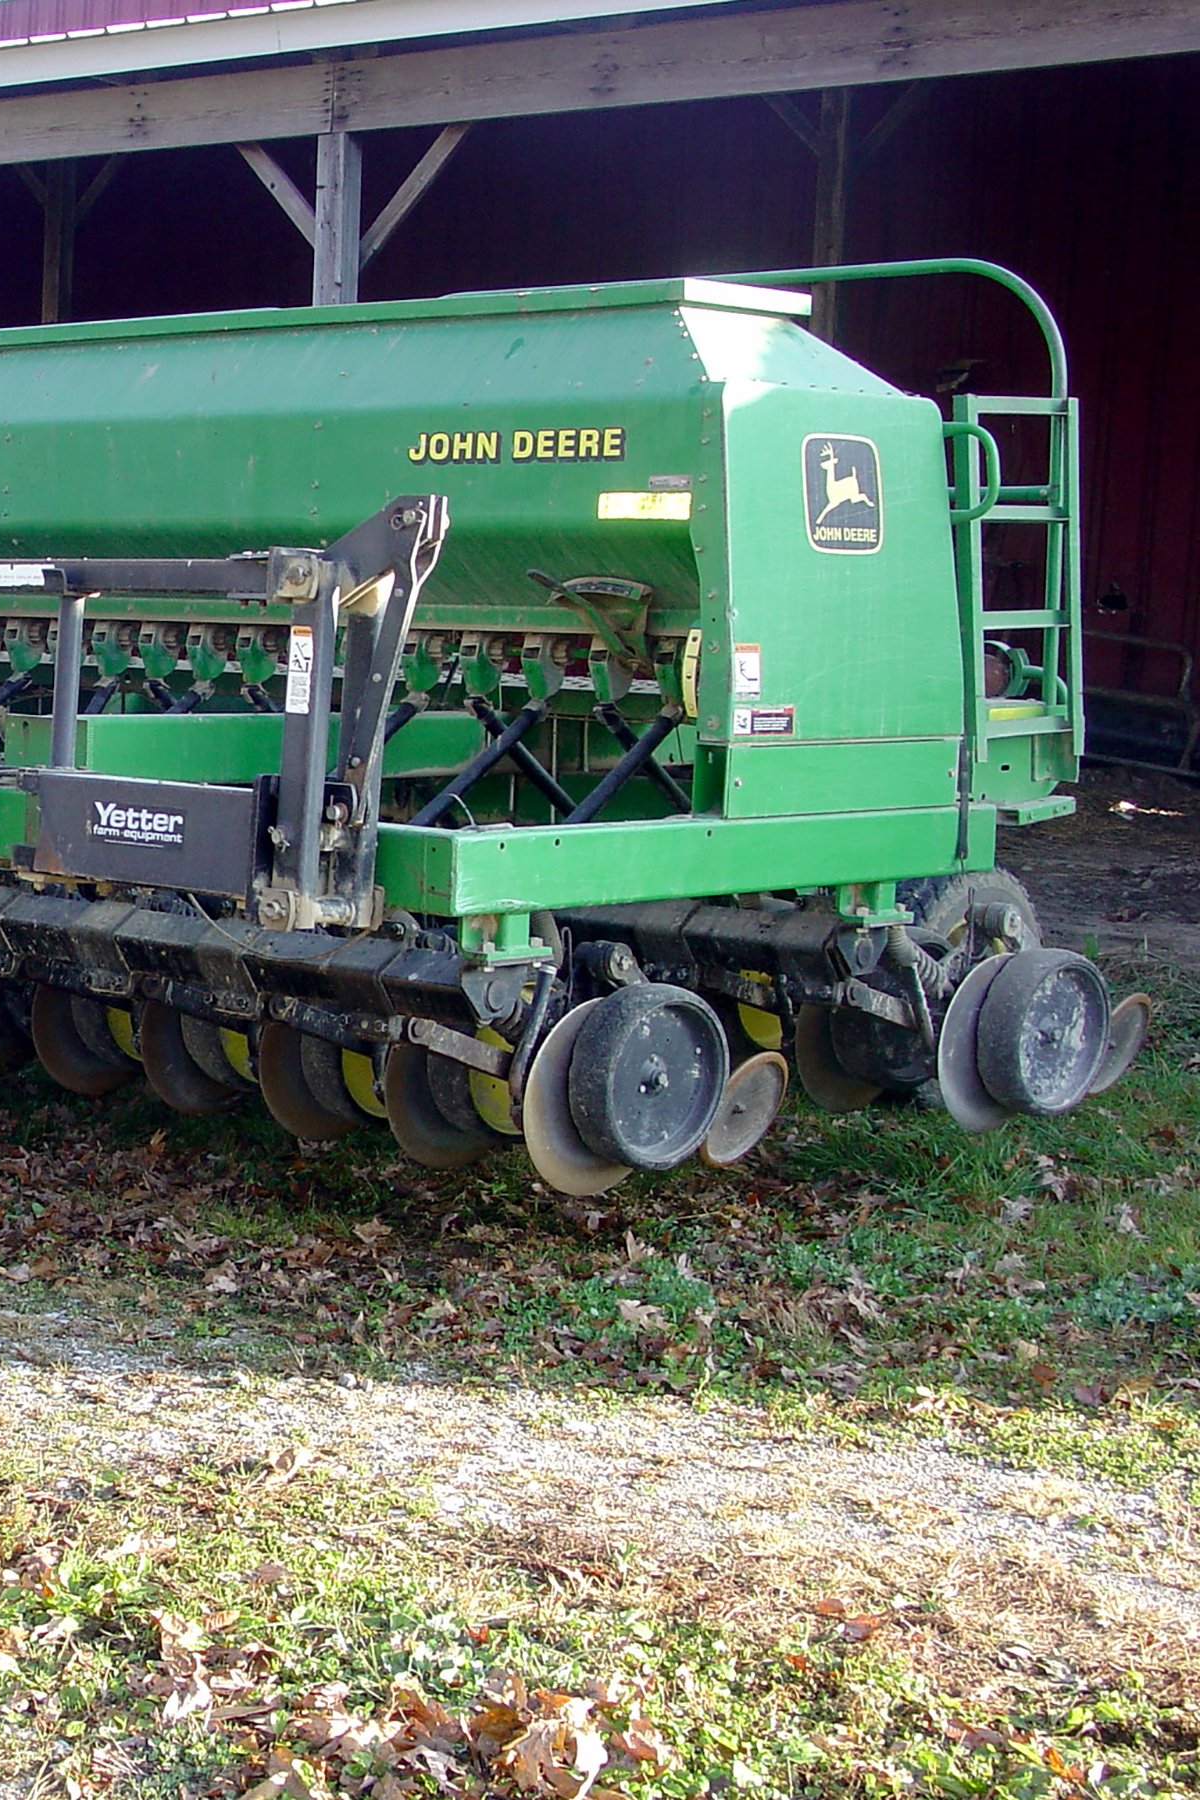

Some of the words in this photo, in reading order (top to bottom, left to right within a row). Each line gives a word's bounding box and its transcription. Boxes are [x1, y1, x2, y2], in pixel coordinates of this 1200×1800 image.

[408, 432, 500, 464] JOHN
[512, 427, 625, 463] DEERE
[813, 526, 842, 541] JOHN
[843, 527, 877, 543] DEERE
[94, 801, 184, 832] Yetter
[93, 824, 120, 836] farm
[123, 829, 183, 843] equipment
